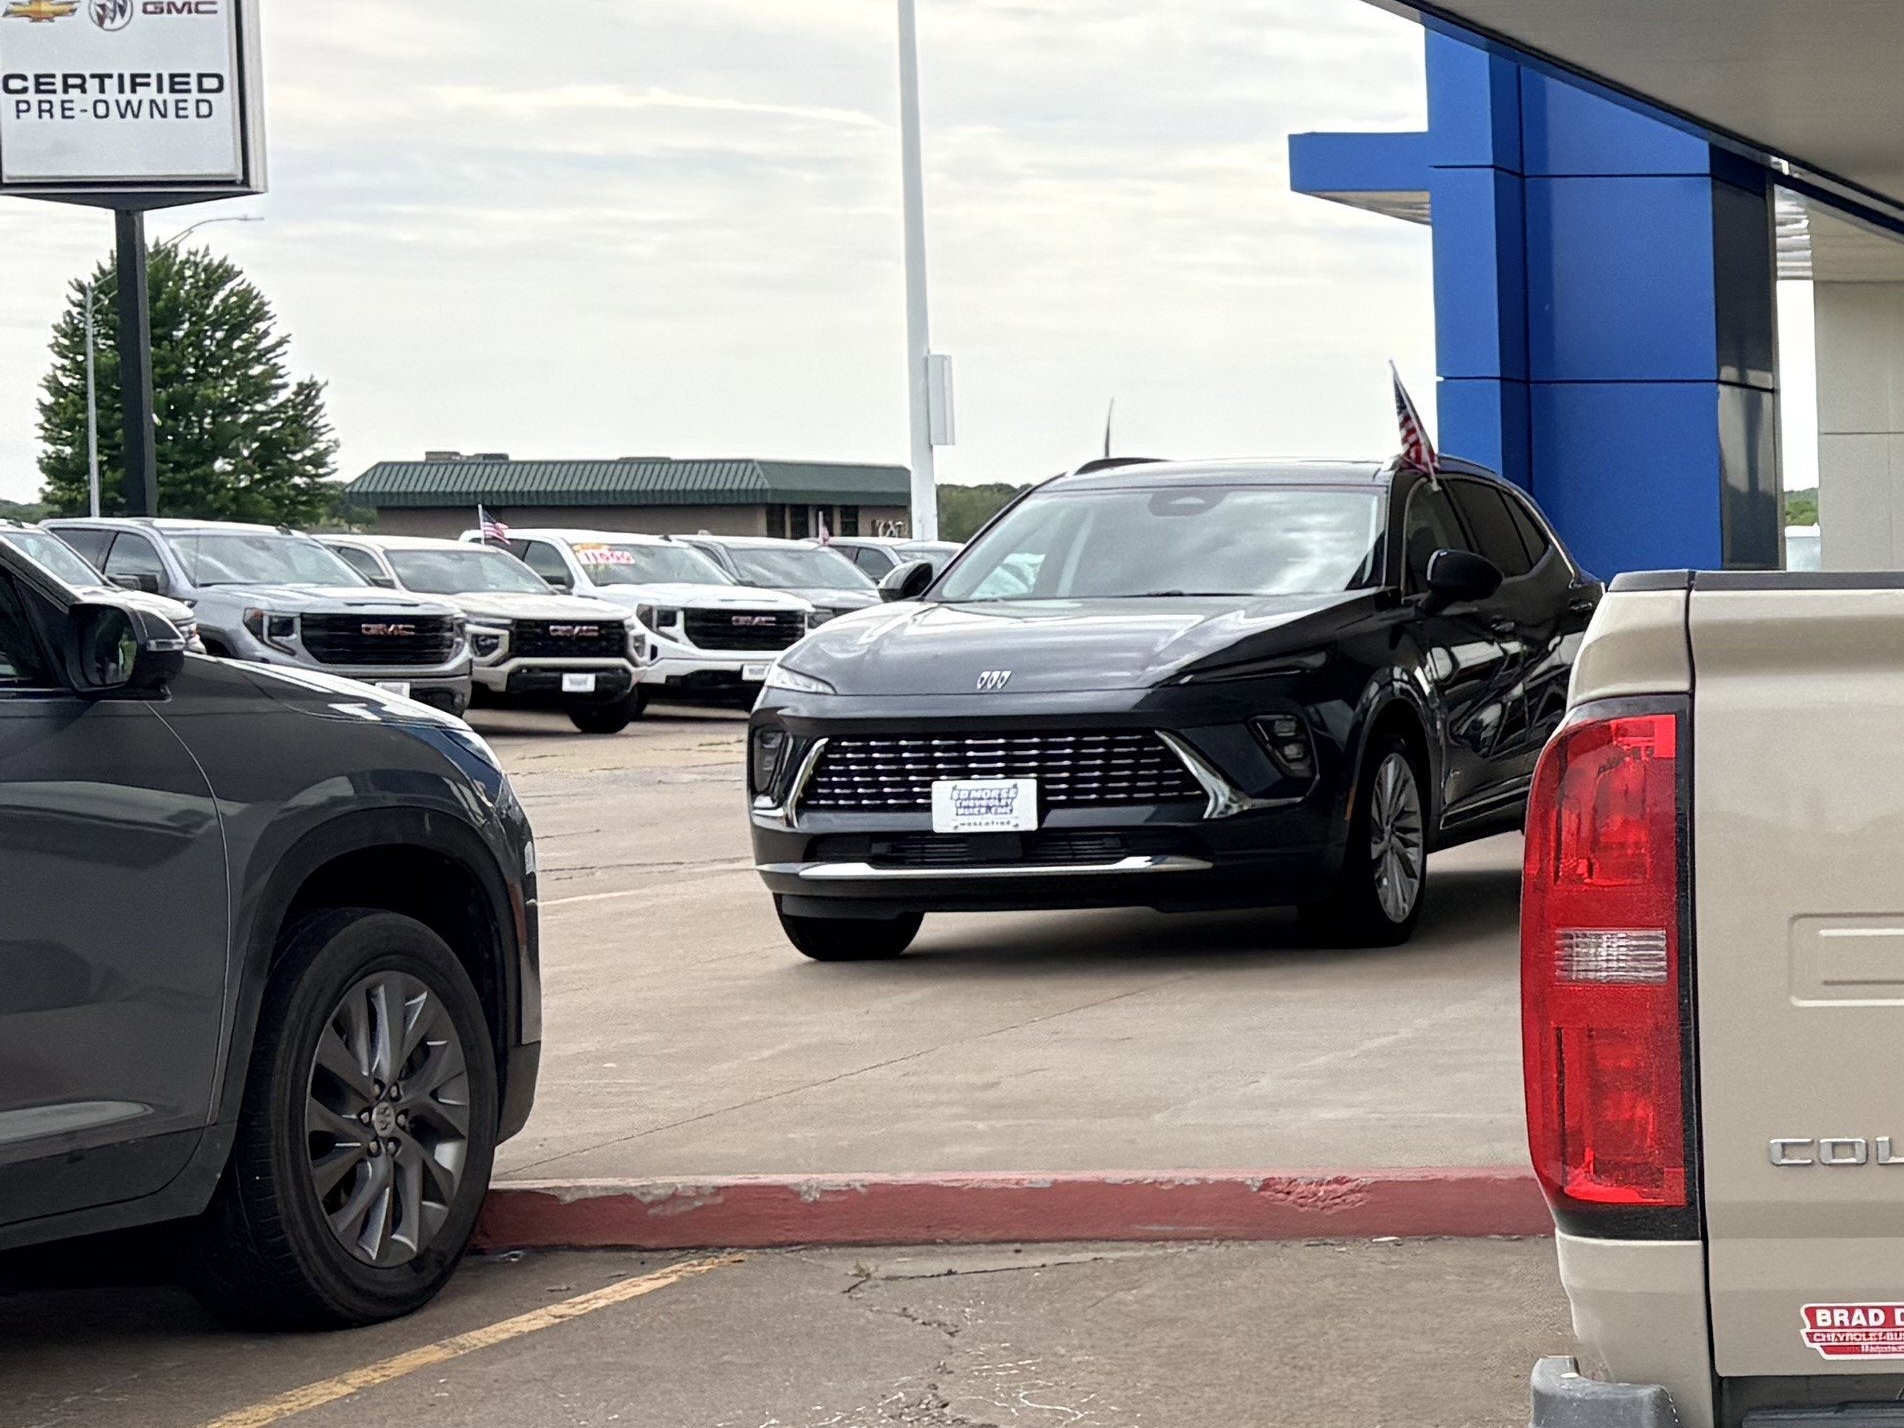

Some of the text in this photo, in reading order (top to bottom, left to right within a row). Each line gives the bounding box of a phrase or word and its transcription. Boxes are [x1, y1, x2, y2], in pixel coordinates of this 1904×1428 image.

[142, 1, 218, 14] GMC
[2, 72, 224, 95] CERTIFIED
[15, 99, 213, 120] PRE-OWNED
[1815, 1308, 1886, 1327] BRAD
